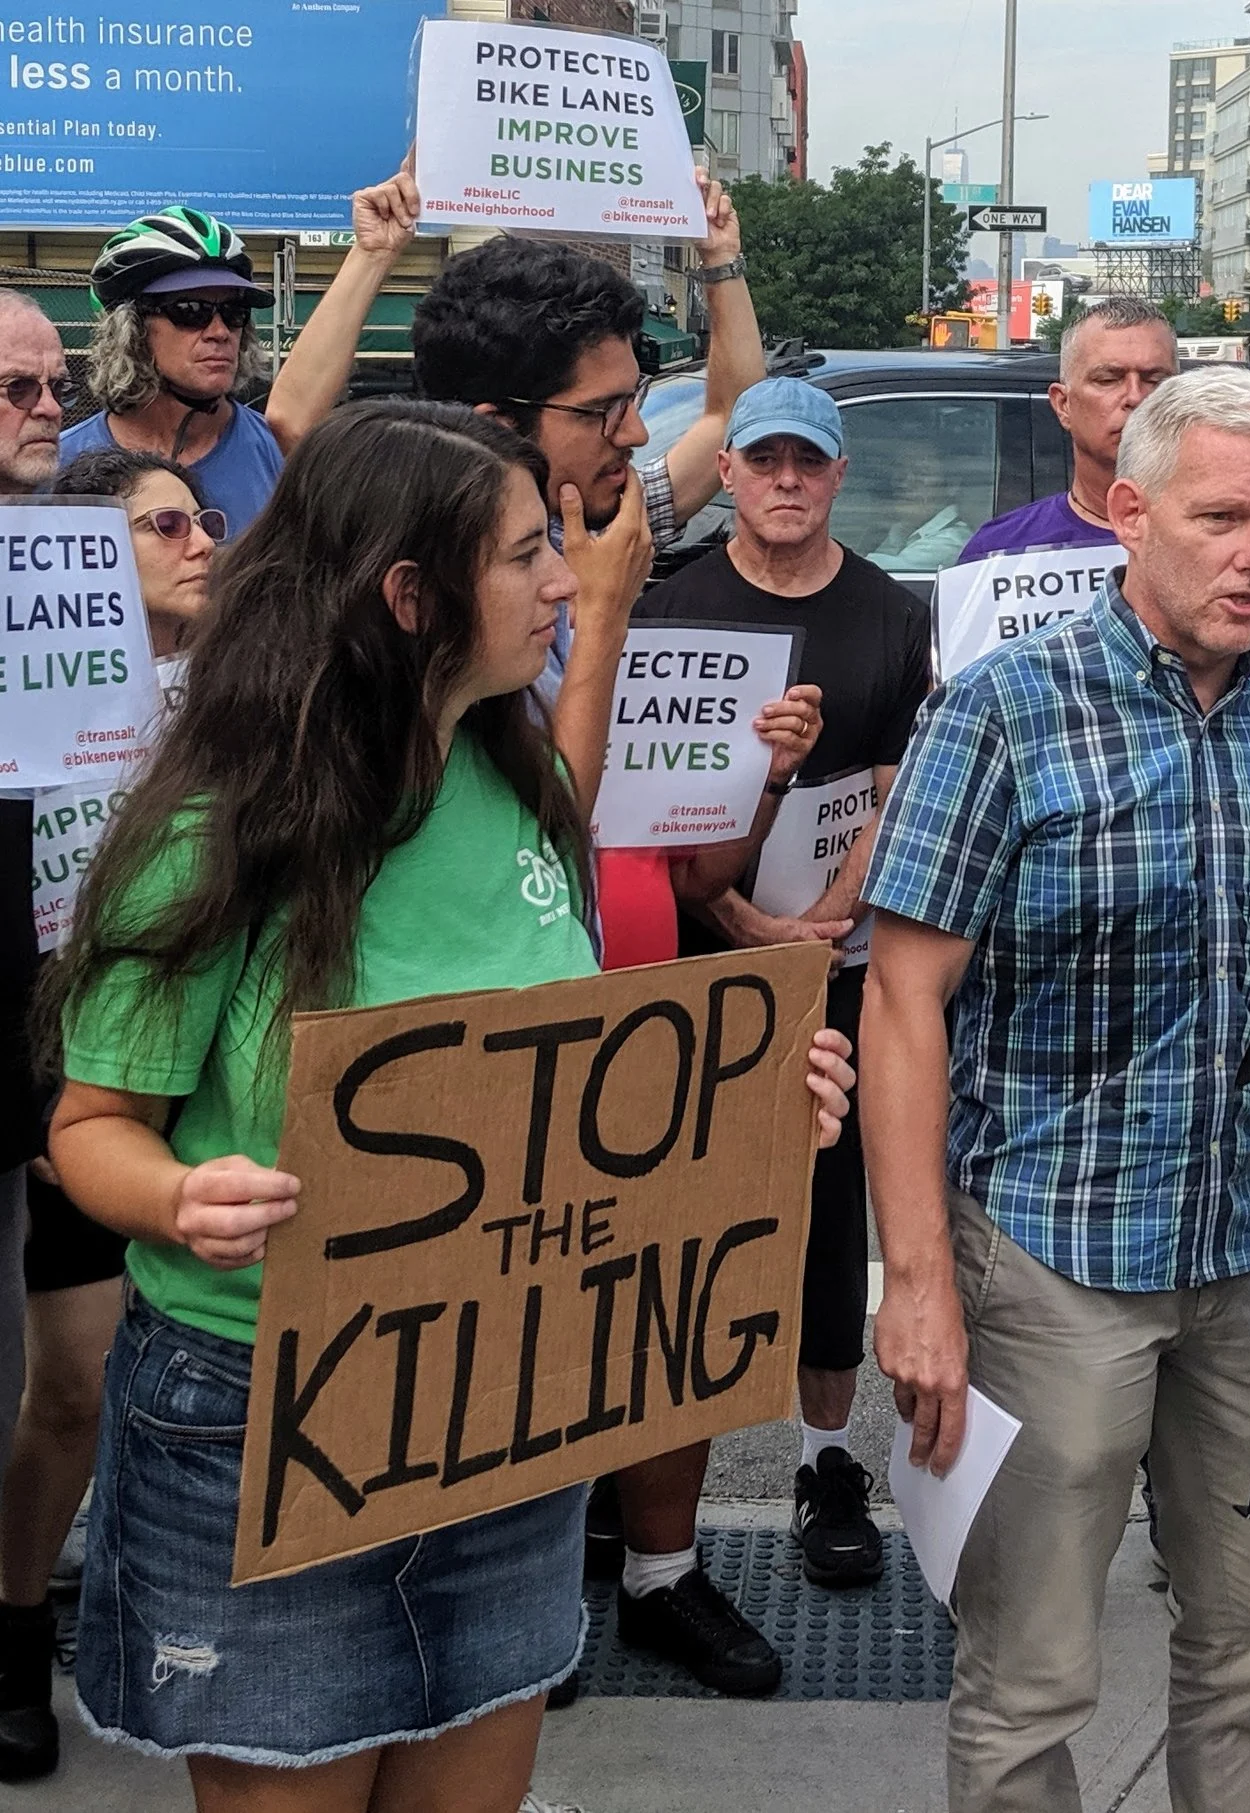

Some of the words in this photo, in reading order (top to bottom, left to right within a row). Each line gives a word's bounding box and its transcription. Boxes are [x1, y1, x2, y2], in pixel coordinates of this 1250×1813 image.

[99, 18, 253, 47] insurance
[10, 54, 91, 90] less
[105, 69, 121, 90] a
[135, 65, 243, 93] month.
[476, 42, 650, 82] PROTECTED
[477, 79, 549, 106] BIKE
[562, 87, 654, 117] LANES
[64, 120, 100, 136] Plan
[108, 121, 162, 141] today.
[497, 117, 639, 150] IMPROVE
[490, 154, 643, 186] BUSINESS
[463, 187, 520, 200] #bikeLIC
[618, 197, 674, 210] @transalt
[1112, 183, 1153, 201] DEAR
[425, 200, 555, 217] #BikeNeighborhood
[601, 210, 689, 225] @bikenewyork
[983, 213, 1006, 224] ONE
[1012, 214, 1036, 224] WAY
[1112, 200, 1150, 217] EVAN
[307, 234, 323, 243] 163
[1112, 216, 1171, 234] HANSEN
[992, 568, 1106, 602] PROTE
[6, 591, 125, 632] LANES
[22, 649, 129, 691] LIVES
[616, 697, 738, 725] LANES
[76, 726, 136, 747] @transalt
[623, 742, 731, 771] LIVES
[668, 803, 728, 818] @transalt
[817, 784, 878, 826] PROTE
[650, 818, 737, 836] @bikenewyork
[324, 974, 776, 1260] STOP
[481, 1196, 619, 1275] THE
[261, 1217, 781, 1549] KILLING
